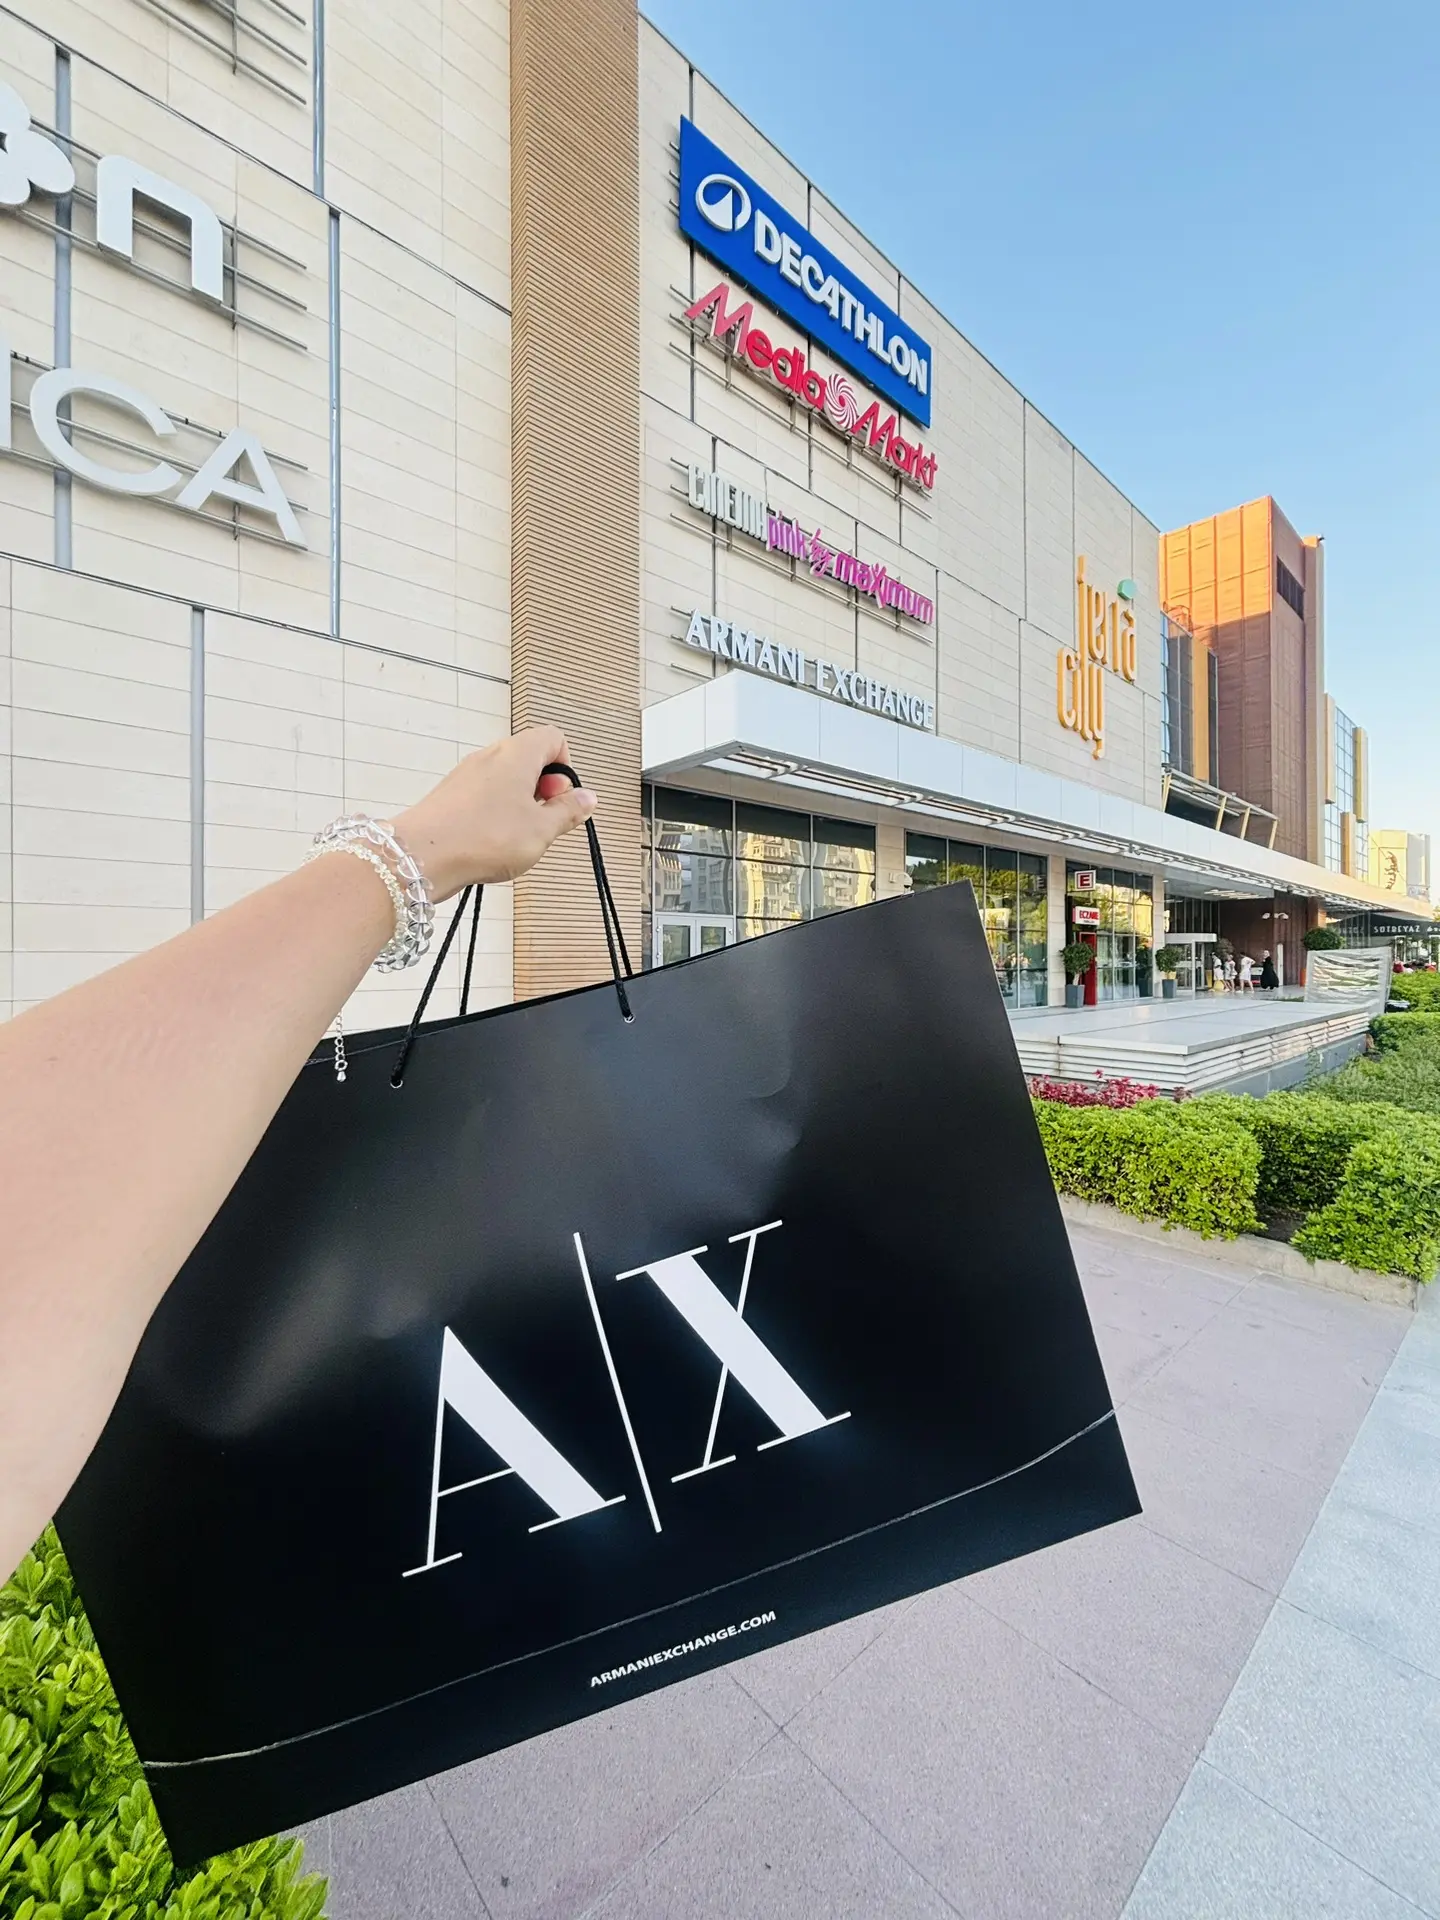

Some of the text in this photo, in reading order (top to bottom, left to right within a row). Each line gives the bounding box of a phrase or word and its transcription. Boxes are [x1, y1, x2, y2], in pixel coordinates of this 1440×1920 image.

[754, 208, 928, 396] DECATHLON
[683, 281, 939, 491] Media Markt
[685, 607, 935, 731] ARMANI EXCHANGE
[1080, 874, 1091, 887] E
[590, 1610, 777, 1688] ARMANIEXCHANGE.COM
